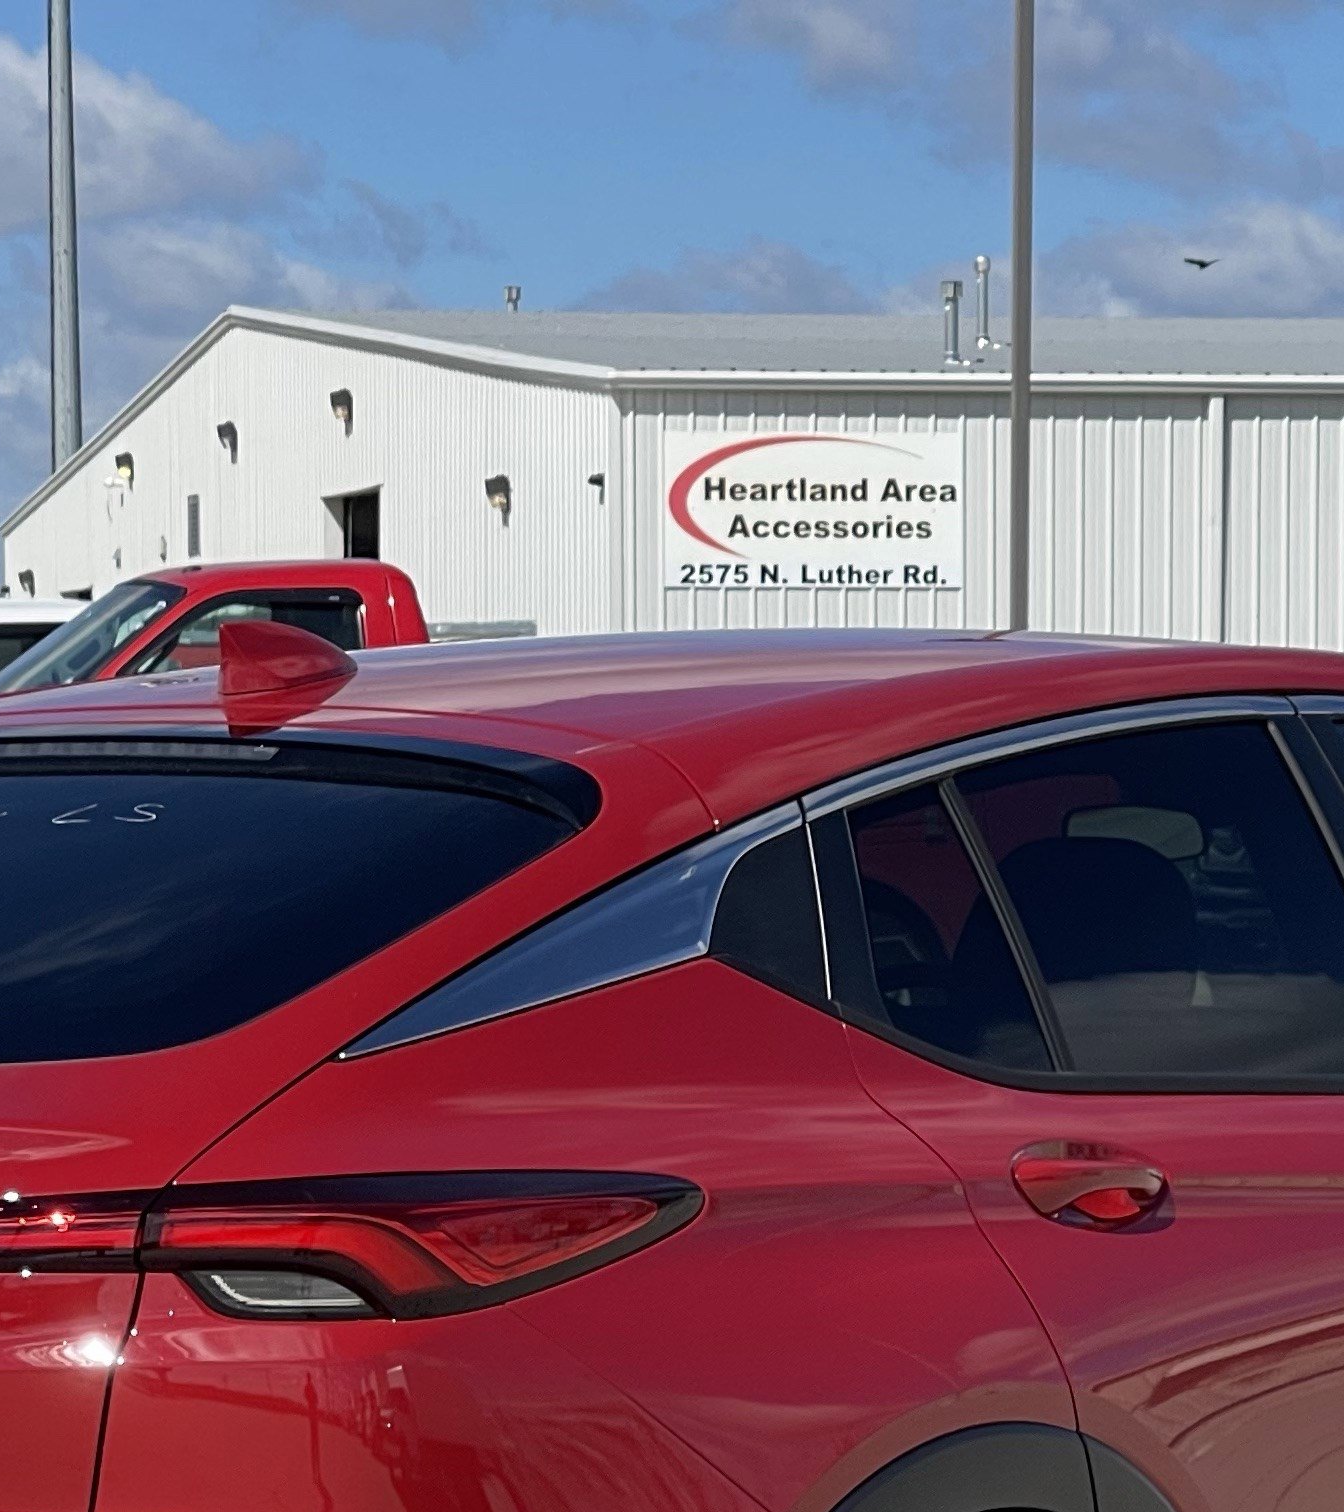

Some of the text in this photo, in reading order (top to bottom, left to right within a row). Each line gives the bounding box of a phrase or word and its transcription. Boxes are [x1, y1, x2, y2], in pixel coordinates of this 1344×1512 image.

[704, 477, 957, 502] Heartland Area
[727, 514, 932, 539] Accessories
[680, 564, 947, 585] 2575 N. Luther Rd.
